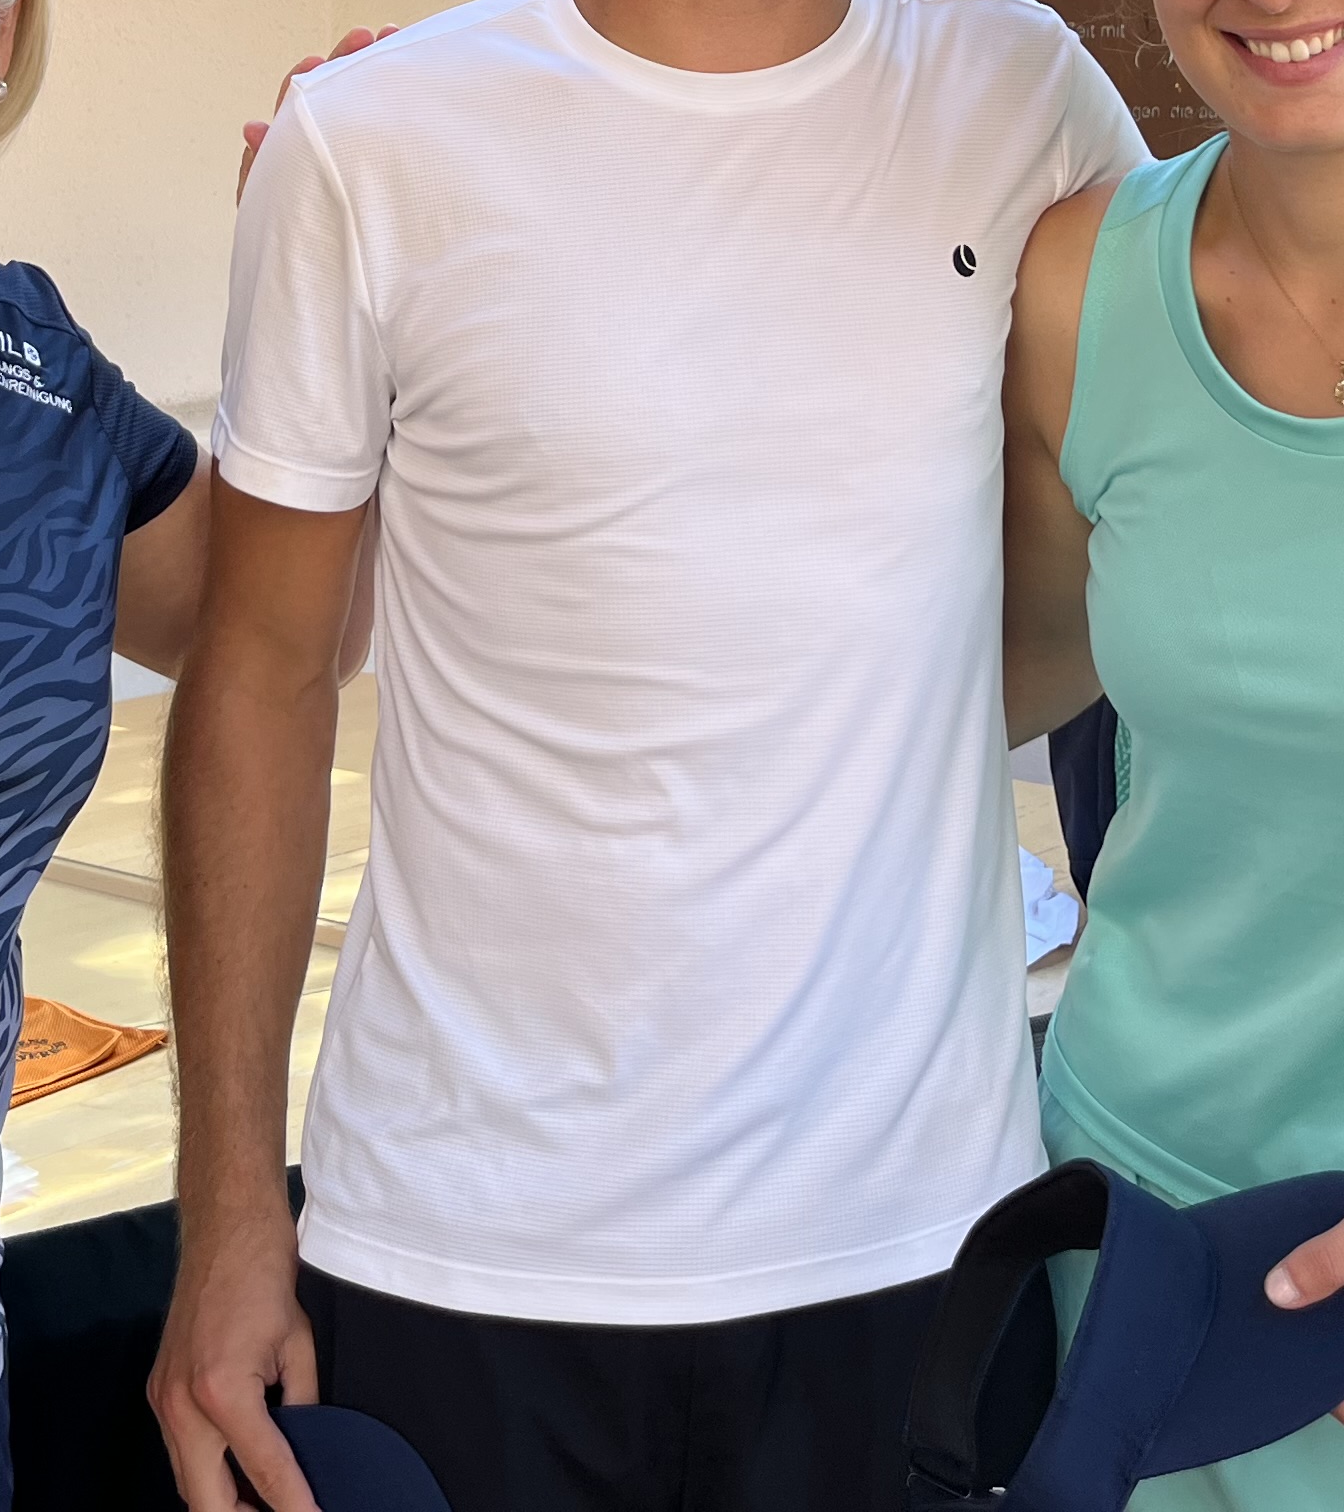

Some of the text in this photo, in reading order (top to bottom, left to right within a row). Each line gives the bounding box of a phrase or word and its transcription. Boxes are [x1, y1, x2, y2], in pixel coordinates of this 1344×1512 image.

[1068, 21, 1126, 39] eit mit
[1171, 104, 1193, 119] die
